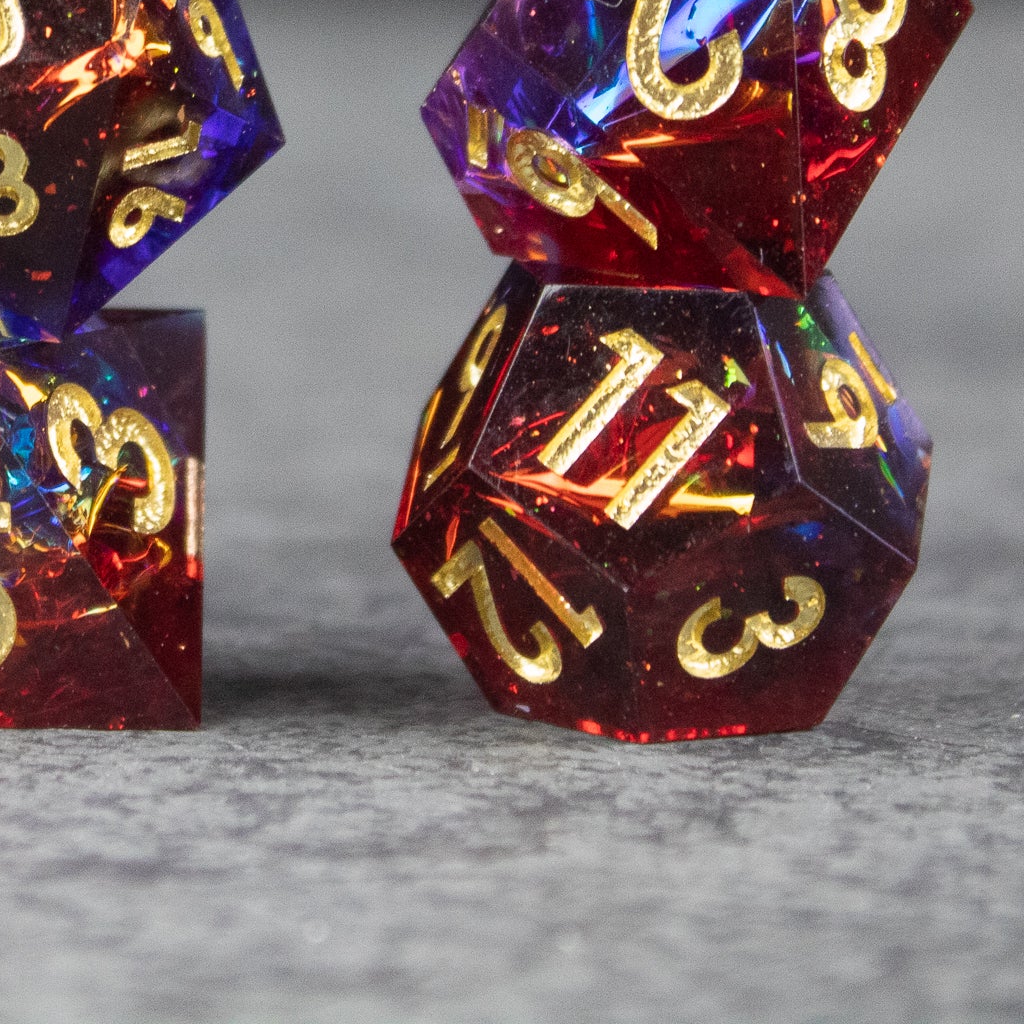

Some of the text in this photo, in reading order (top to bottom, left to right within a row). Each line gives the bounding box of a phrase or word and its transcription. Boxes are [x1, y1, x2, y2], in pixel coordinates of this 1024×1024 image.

[537, 328, 732, 530] 11
[430, 516, 605, 685] 12
[677, 575, 827, 680] 3
